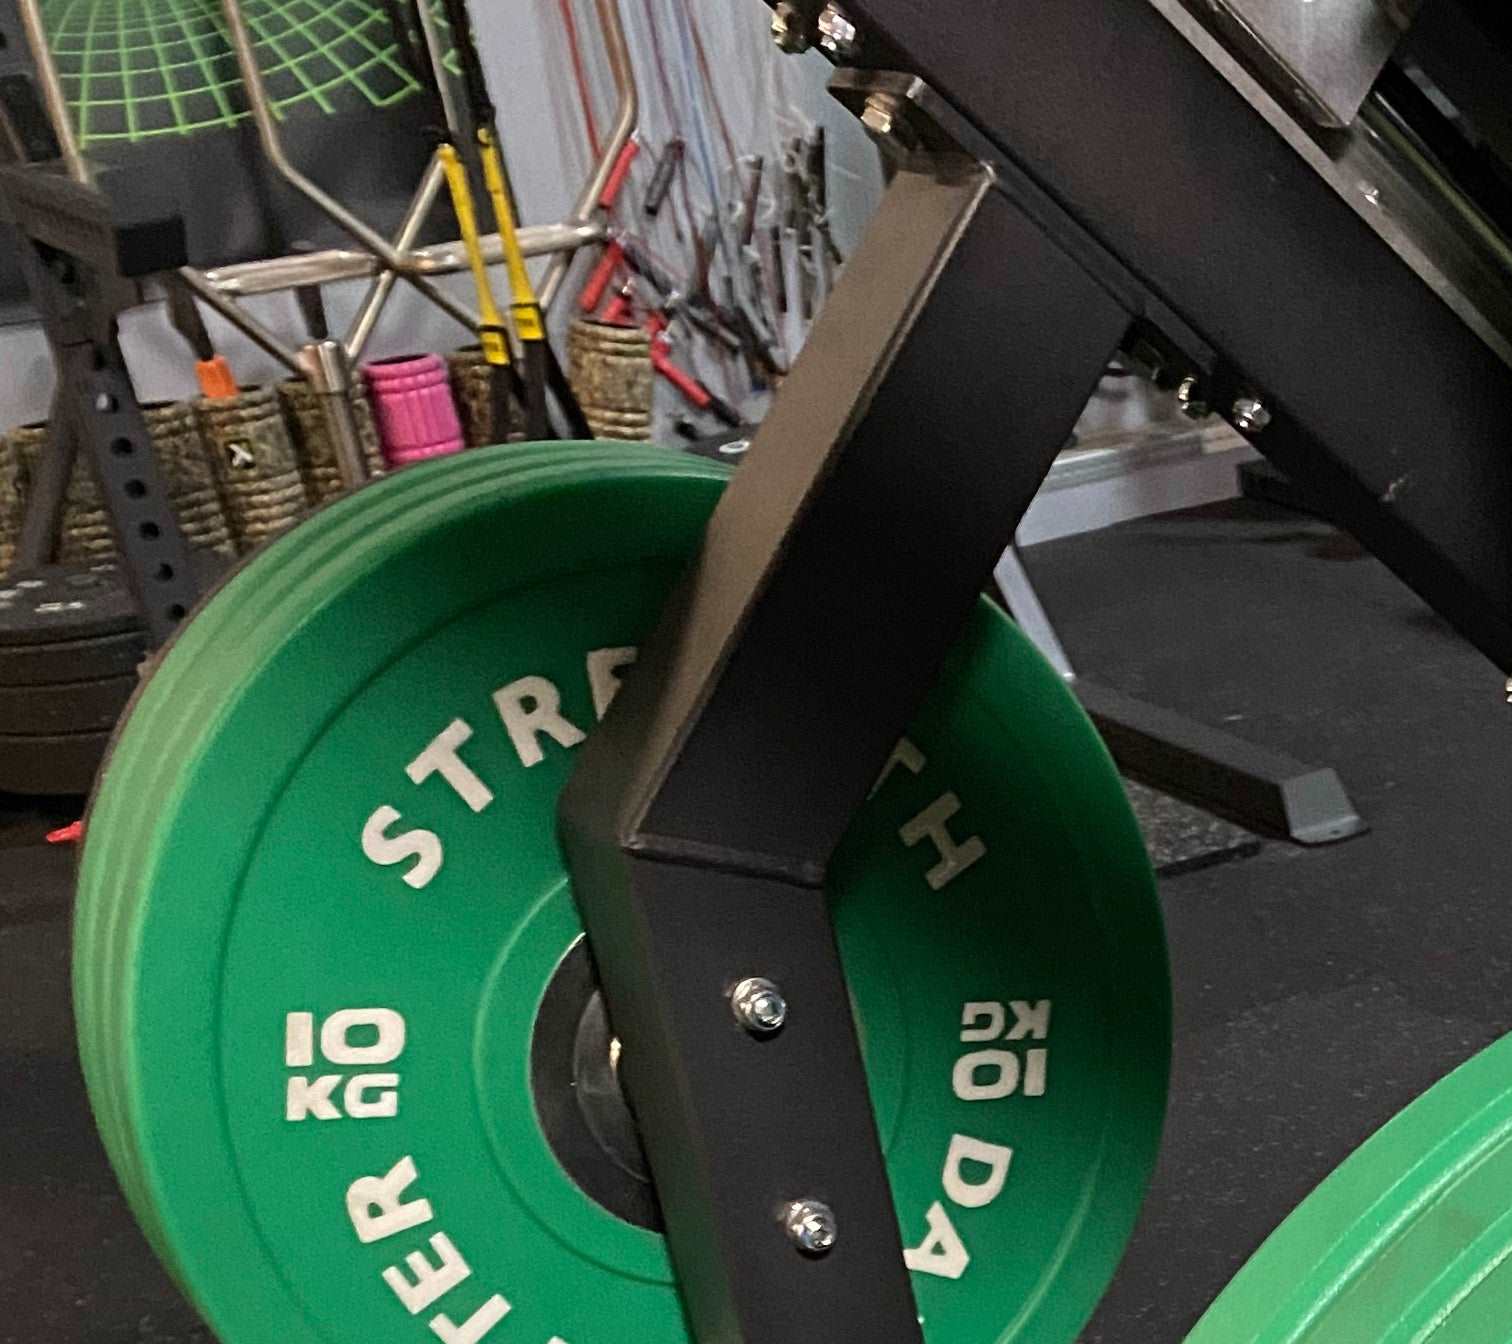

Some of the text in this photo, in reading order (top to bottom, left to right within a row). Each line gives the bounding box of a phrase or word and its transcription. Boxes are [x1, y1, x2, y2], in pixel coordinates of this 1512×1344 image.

[284, 1007, 407, 1068] 10
[959, 1001, 1052, 1042] KG
[284, 1071, 400, 1121] KG
[951, 1048, 1047, 1101] 10
[903, 1133, 1014, 1279] DA
